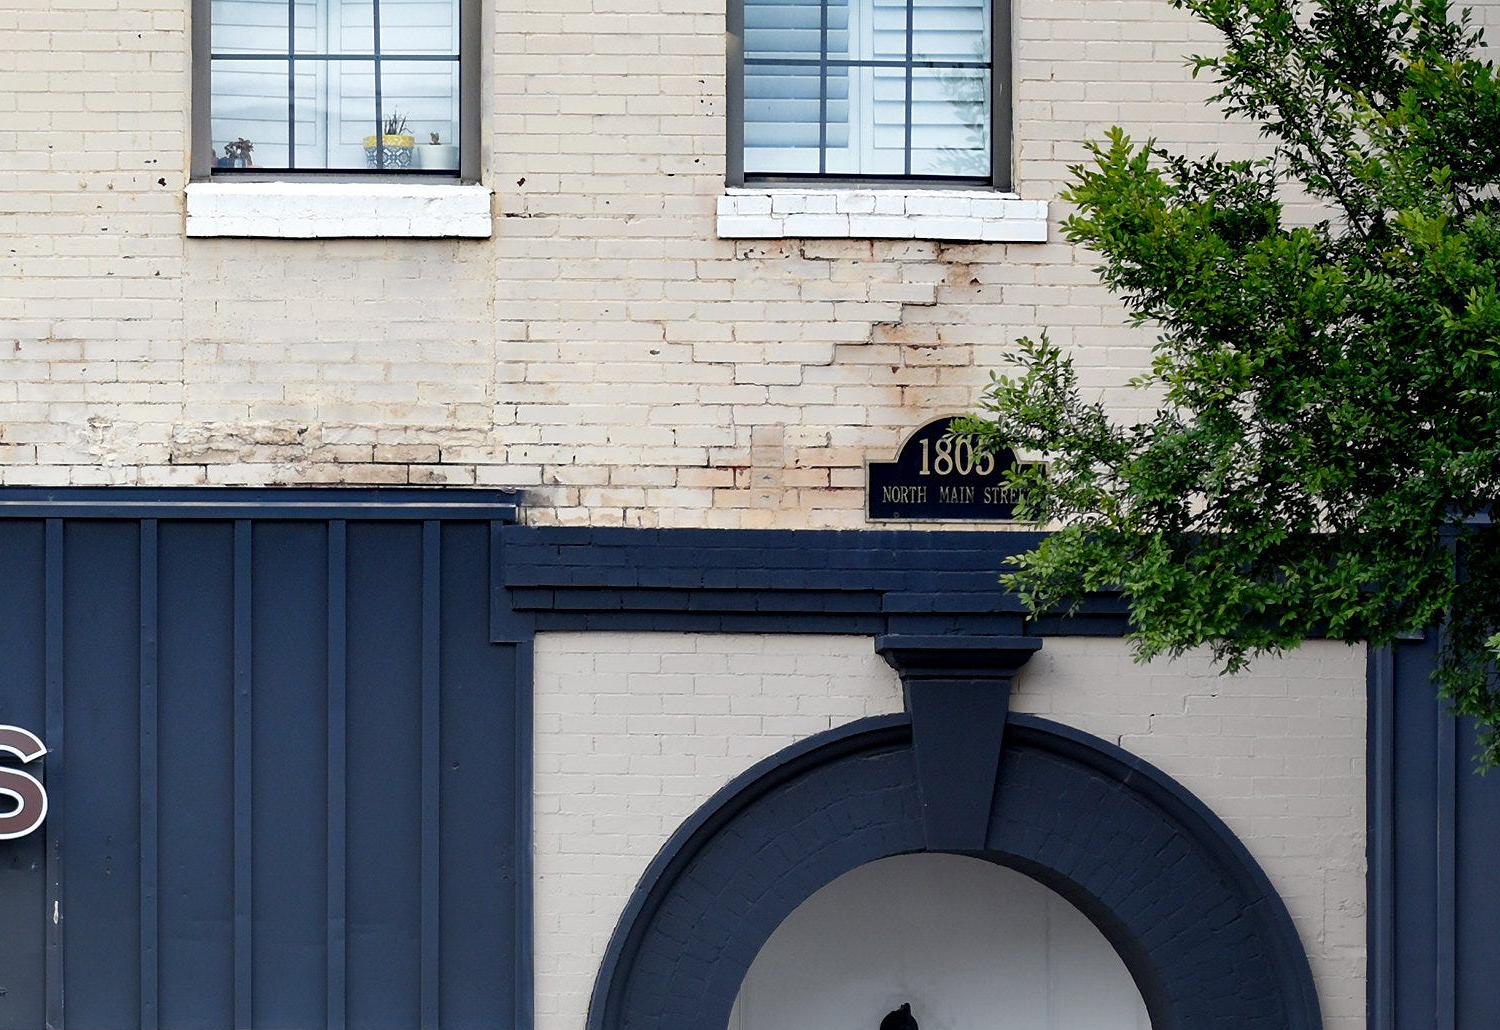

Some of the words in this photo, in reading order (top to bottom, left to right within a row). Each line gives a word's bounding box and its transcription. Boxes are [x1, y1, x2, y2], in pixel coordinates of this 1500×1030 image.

[883, 486, 927, 503] NORTH
[939, 486, 975, 504] MAIN
[984, 486, 1032, 504] STREE
